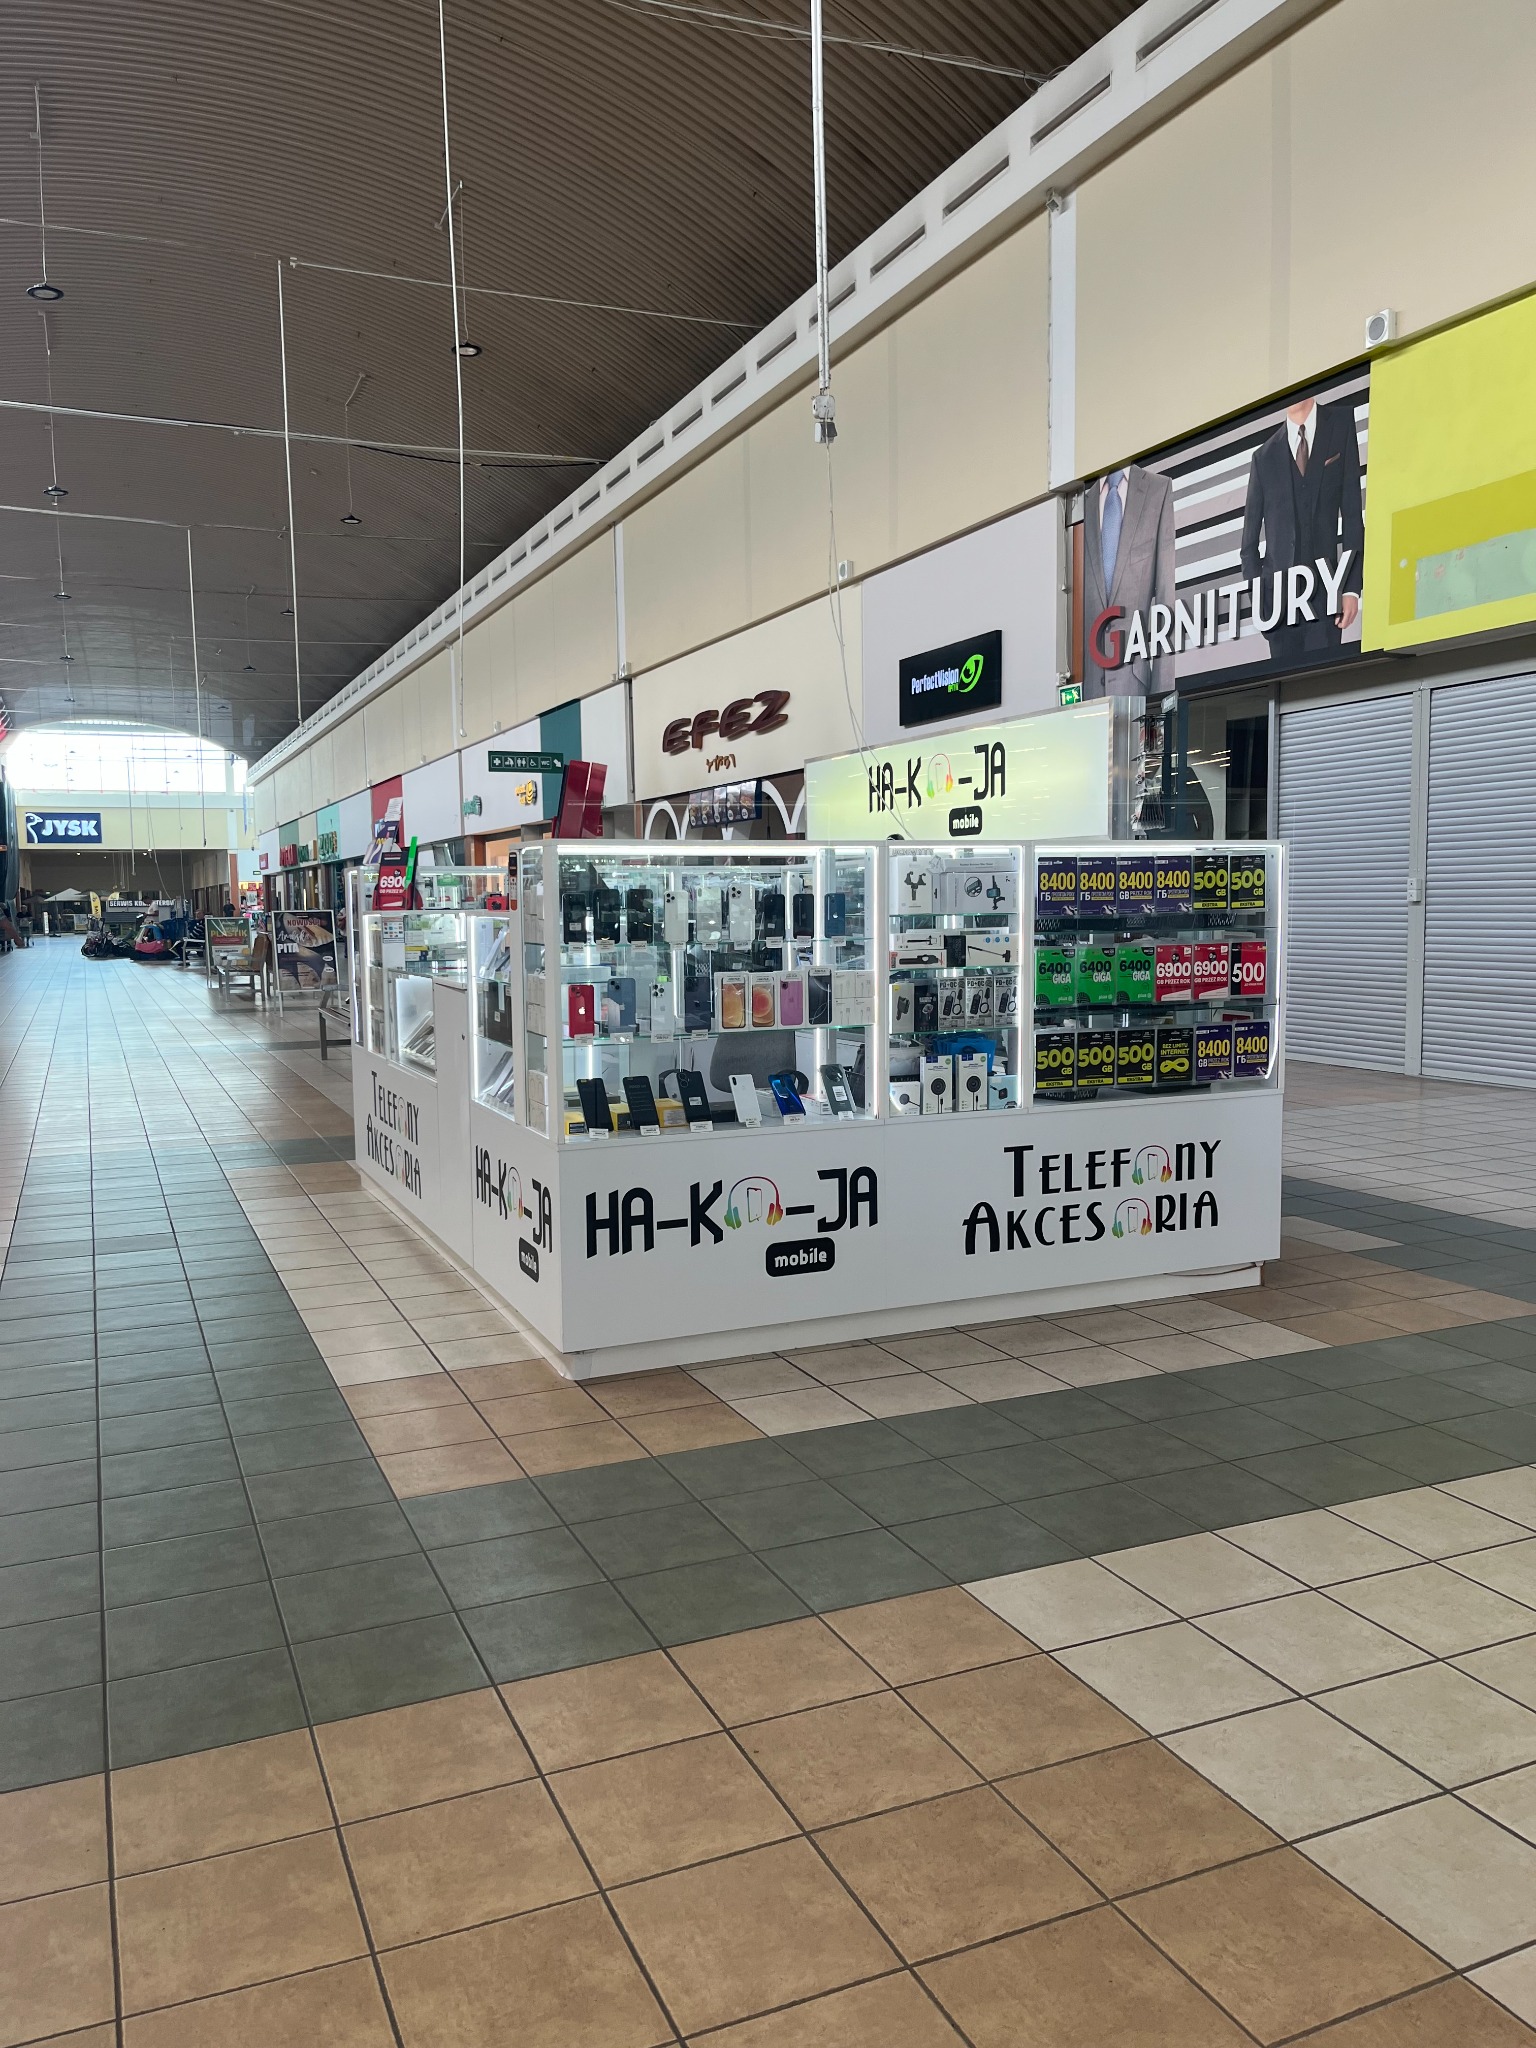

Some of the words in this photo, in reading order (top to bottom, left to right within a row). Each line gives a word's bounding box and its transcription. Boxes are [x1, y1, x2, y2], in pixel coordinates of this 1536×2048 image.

[1089, 549, 1354, 669] GARNITURY
[911, 668, 959, 695] PerfectVision
[662, 690, 791, 755] EFEZ
[41, 820, 98, 836] JYSK
[952, 814, 979, 830] mobile
[1040, 872, 1076, 891] 8400
[1080, 872, 1115, 891] 8400
[1119, 871, 1154, 890] 8400
[1156, 870, 1191, 889] 8400
[1193, 868, 1228, 891] 500
[1231, 868, 1265, 891] 500
[1040, 892, 1051, 901] ГБ
[1080, 892, 1091, 901] ГБ
[1120, 891, 1130, 900] GB
[1157, 889, 1167, 899] ГБ
[1216, 888, 1226, 896] GB
[1253, 888, 1264, 896] GB
[277, 943, 299, 953] PITA
[1039, 962, 1071, 974] 6400
[1080, 961, 1111, 973] 6400
[1120, 960, 1151, 972] 6400
[1156, 962, 1191, 977] 6900
[1194, 960, 1228, 976] 6900
[1232, 962, 1265, 982] 500
[1052, 974, 1071, 984] GIGA
[1093, 972, 1111, 982] GIGA
[1133, 971, 1151, 981] GIGA
[1198, 1039, 1230, 1057] 8400
[1236, 1036, 1268, 1054] 8400
[1037, 1047, 1074, 1070] 500
[1078, 1045, 1115, 1067] 500
[1118, 1043, 1154, 1065] 500
[1236, 1055, 1246, 1064] ГБ
[1061, 1067, 1073, 1075] GB
[1198, 1059, 1207, 1067] GB
[520, 1251, 537, 1274] mobile
[774, 1248, 827, 1269] mobile
